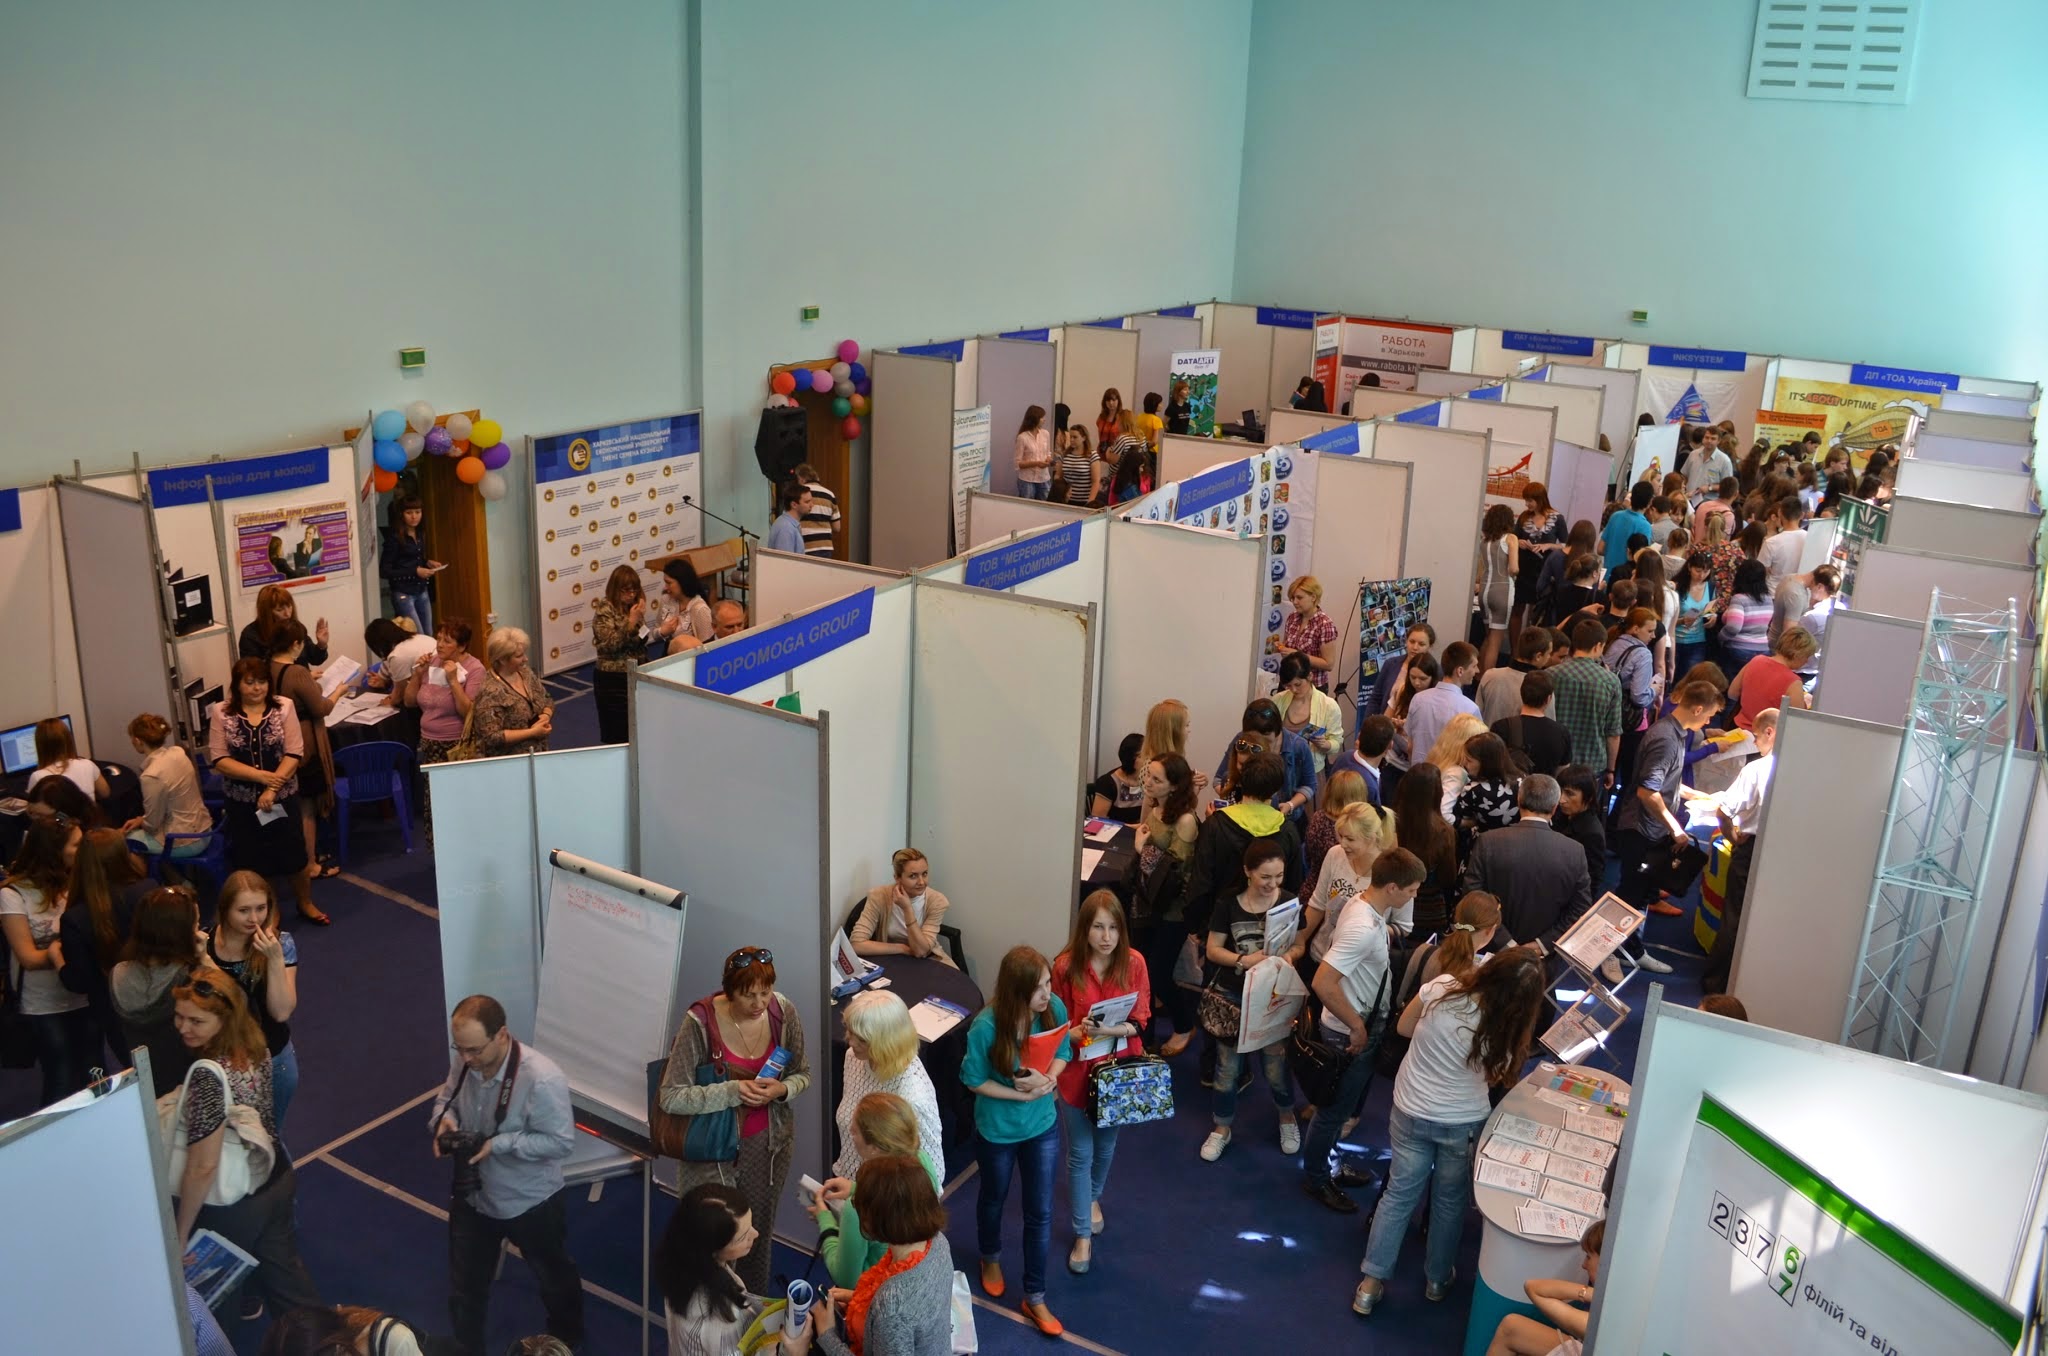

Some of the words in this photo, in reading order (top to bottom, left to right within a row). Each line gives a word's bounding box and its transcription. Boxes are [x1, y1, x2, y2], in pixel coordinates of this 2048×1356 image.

[1381, 335, 1426, 349] РАБОТА
[1388, 347, 1425, 358] Харькове
[1672, 353, 1724, 364] INKSYSTEM
[1360, 359, 1417, 373] www.rabota.kh
[1863, 371, 1880, 380] ДП
[1840, 398, 1878, 411] UPTIME
[164, 473, 243, 492] Інфорація
[246, 470, 271, 483] для
[274, 463, 316, 478] молоді
[1191, 476, 1236, 500] Entertainment
[1237, 470, 1247, 484] AB
[979, 557, 999, 575] ТОВ
[978, 568, 1017, 588] СКЛЯНА
[706, 632, 805, 686] DOPOMOGA
[808, 607, 861, 644] GROUP
[1803, 1283, 1845, 1324] філій
[1848, 1316, 1867, 1340] та
